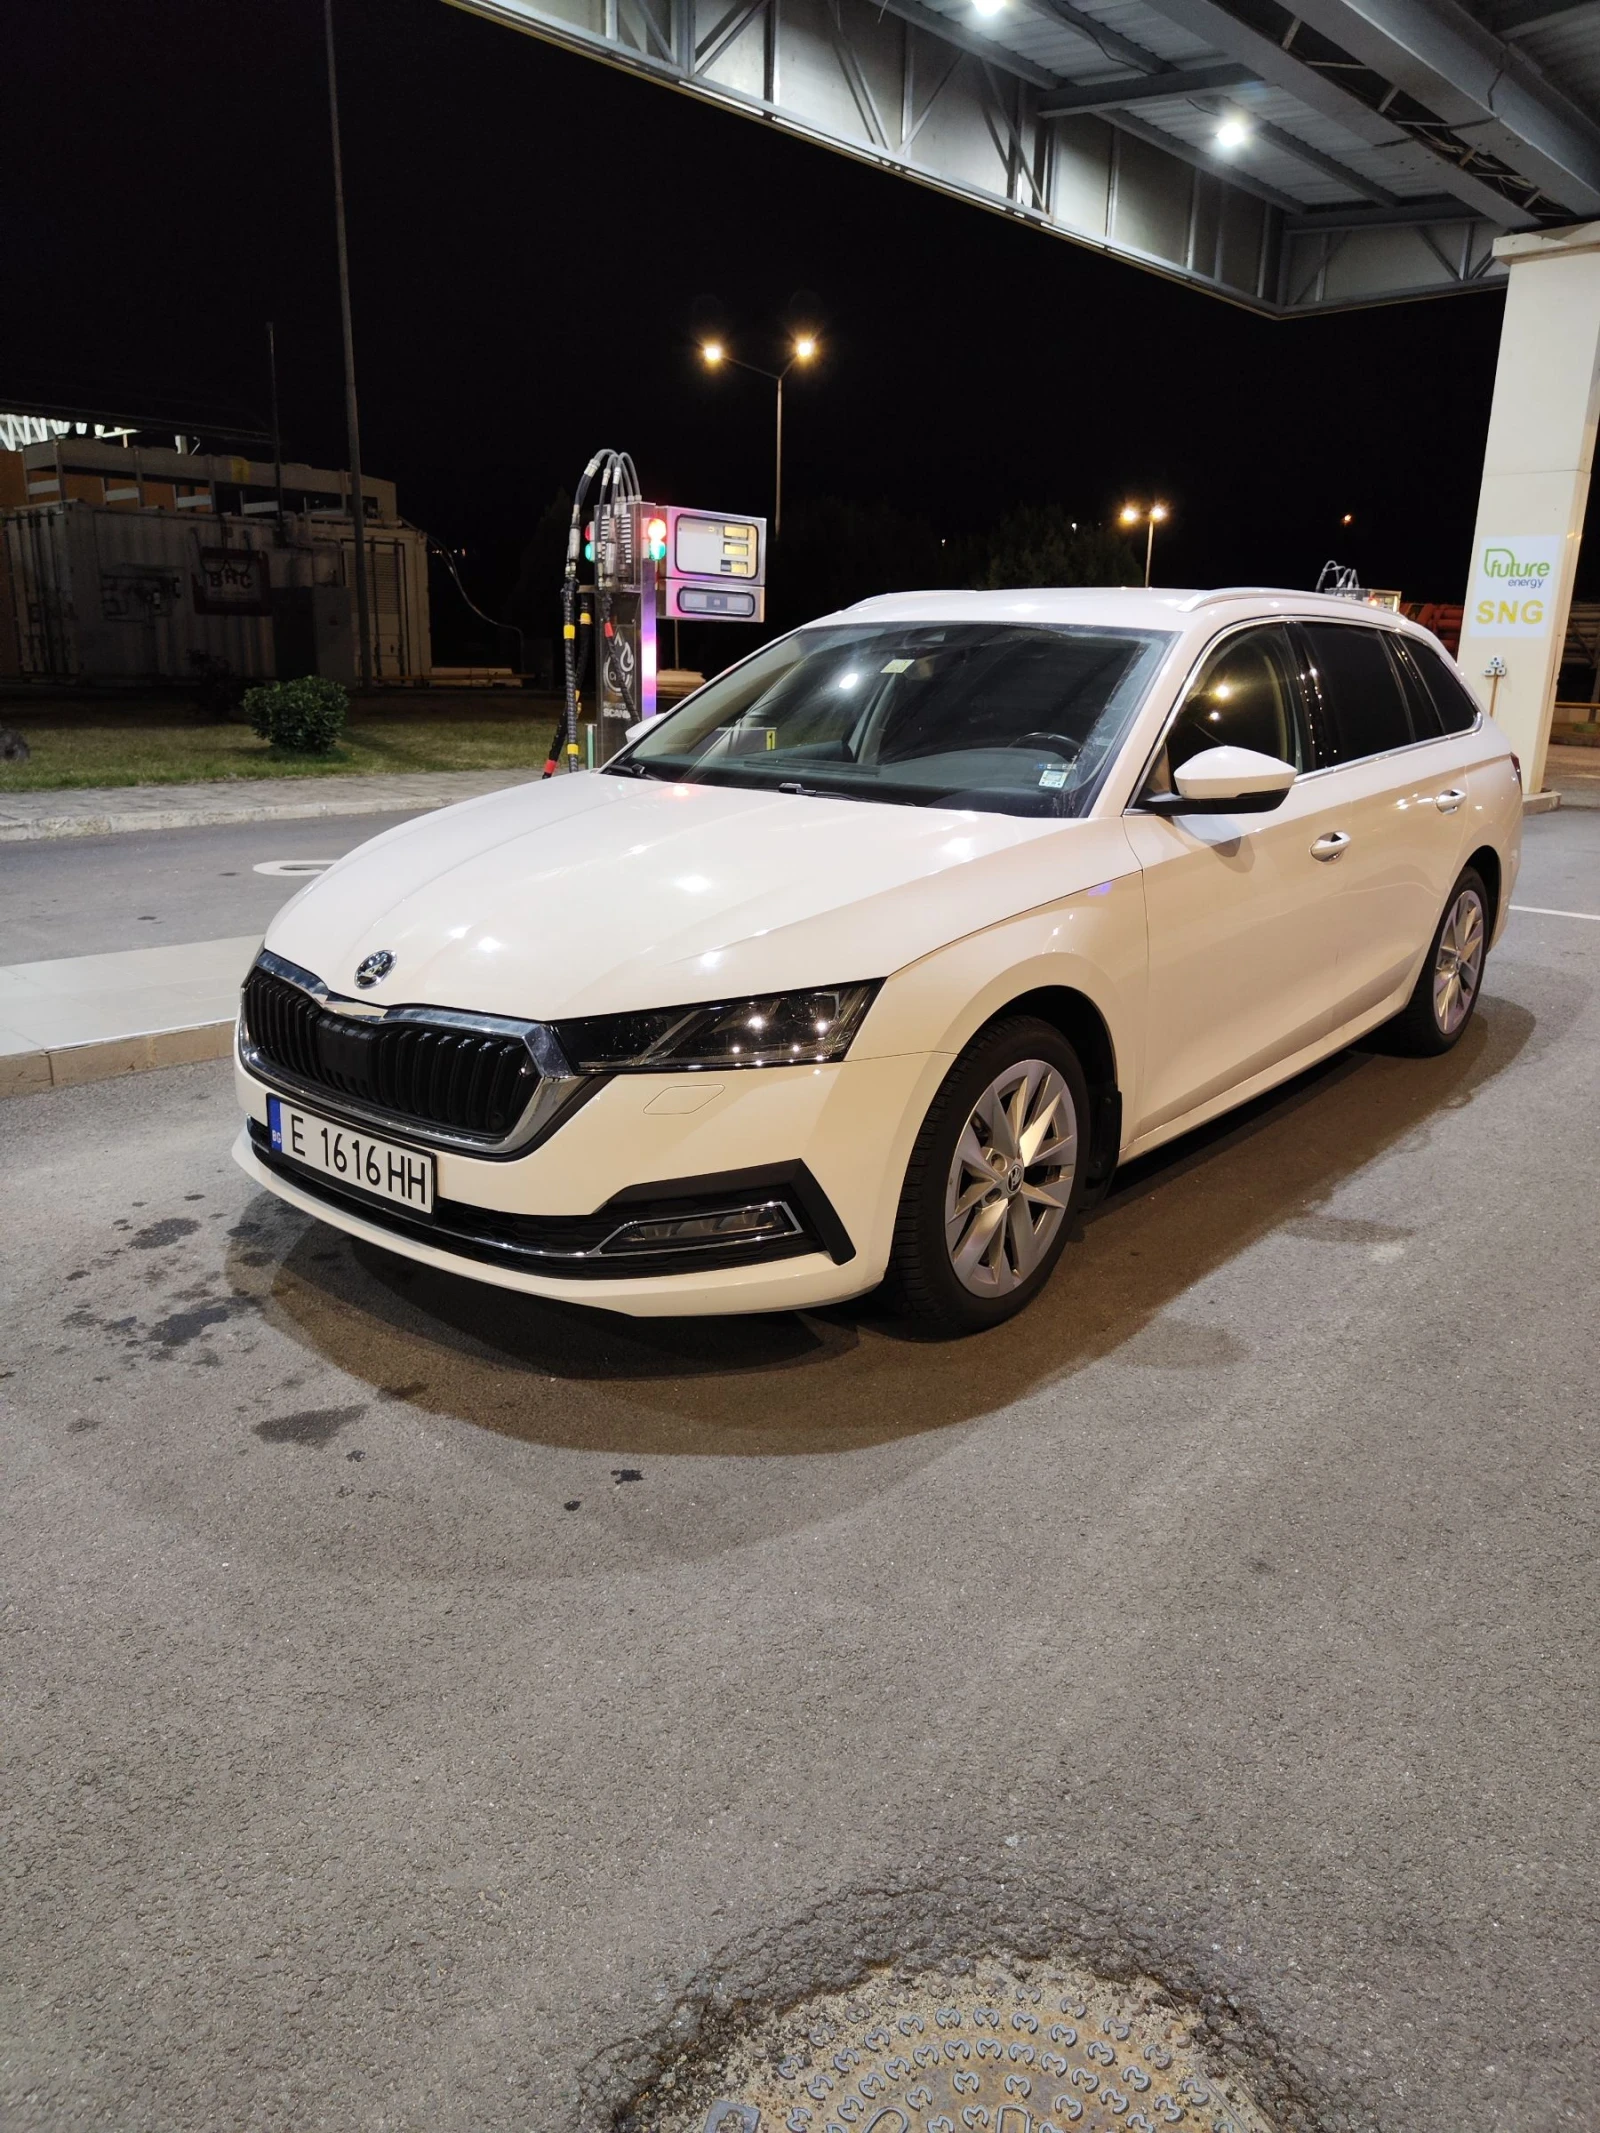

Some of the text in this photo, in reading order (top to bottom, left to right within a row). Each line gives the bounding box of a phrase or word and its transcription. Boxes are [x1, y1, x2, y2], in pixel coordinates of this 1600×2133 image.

[1484, 550, 1551, 578] future
[1508, 578, 1543, 588] energy
[1476, 600, 1544, 625] SNG
[272, 1130, 282, 1143] BG
